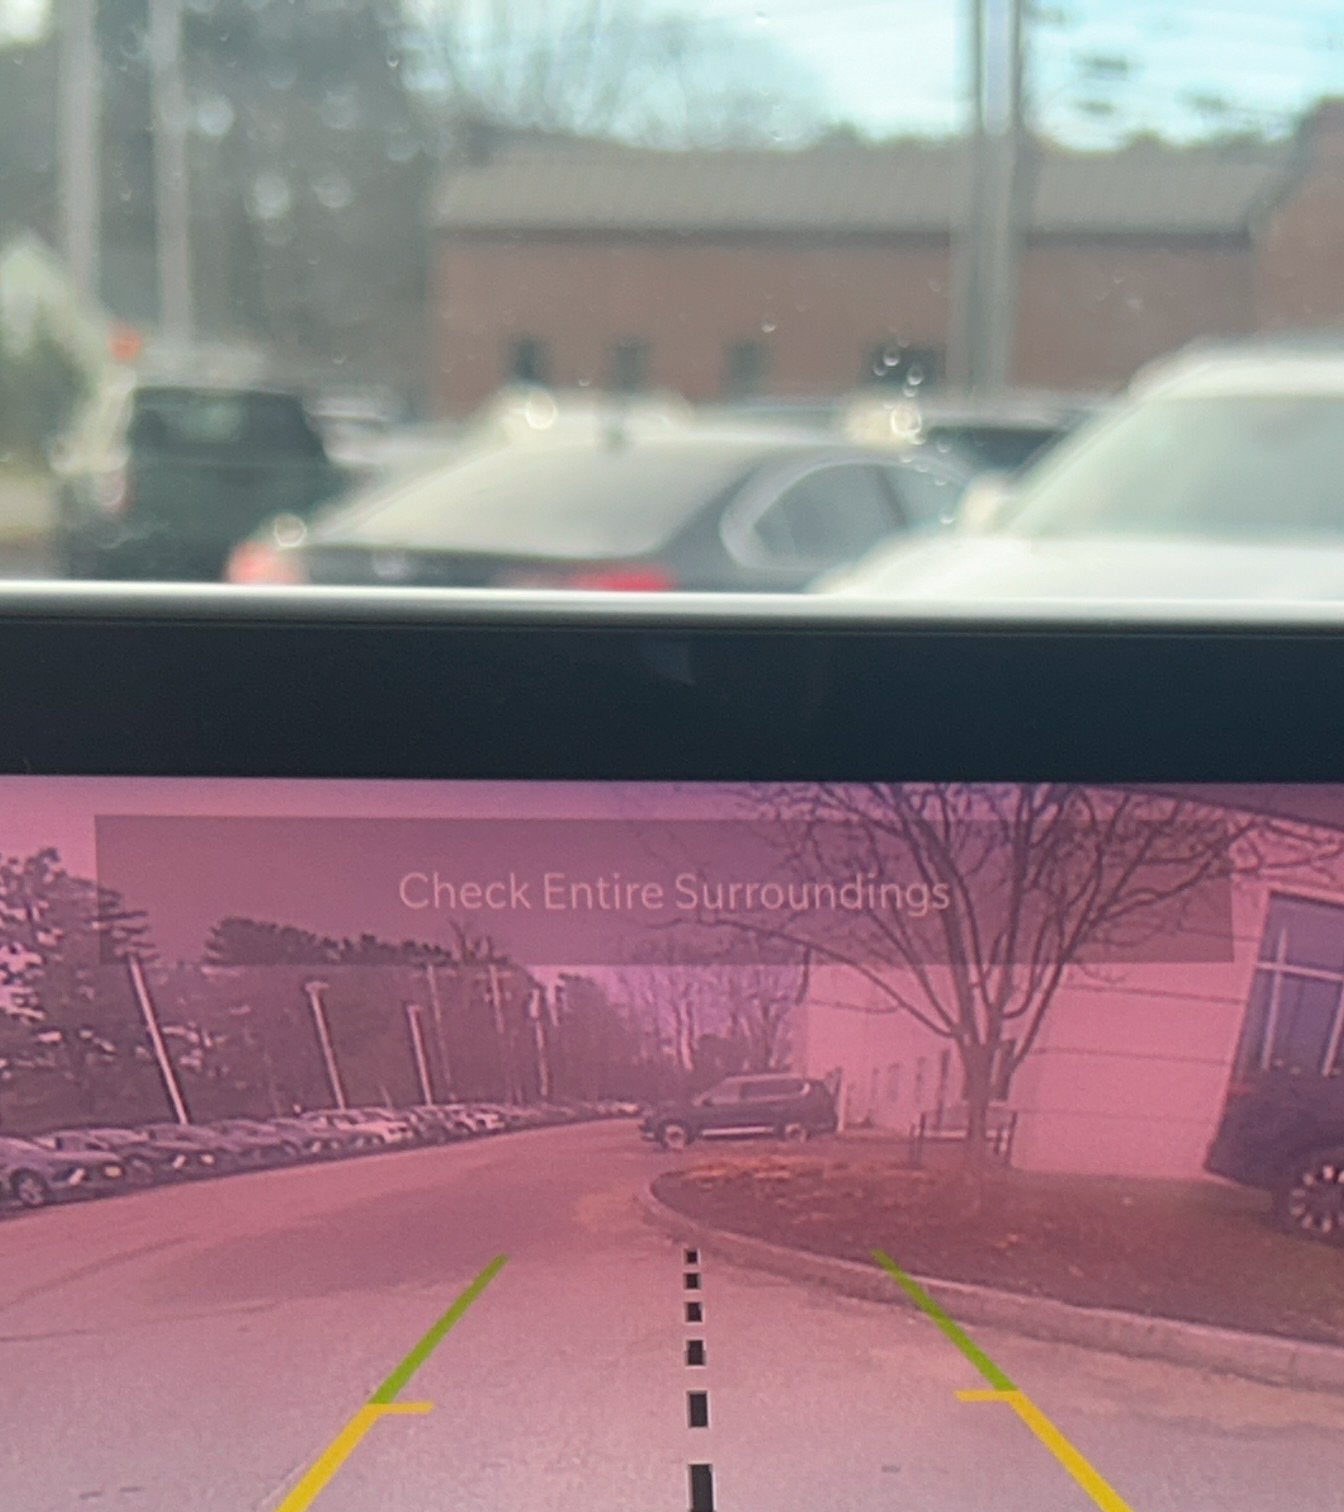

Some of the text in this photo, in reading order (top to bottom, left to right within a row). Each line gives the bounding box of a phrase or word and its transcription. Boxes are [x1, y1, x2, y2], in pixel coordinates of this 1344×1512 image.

[399, 871, 951, 917] Check Entire Surroundings
